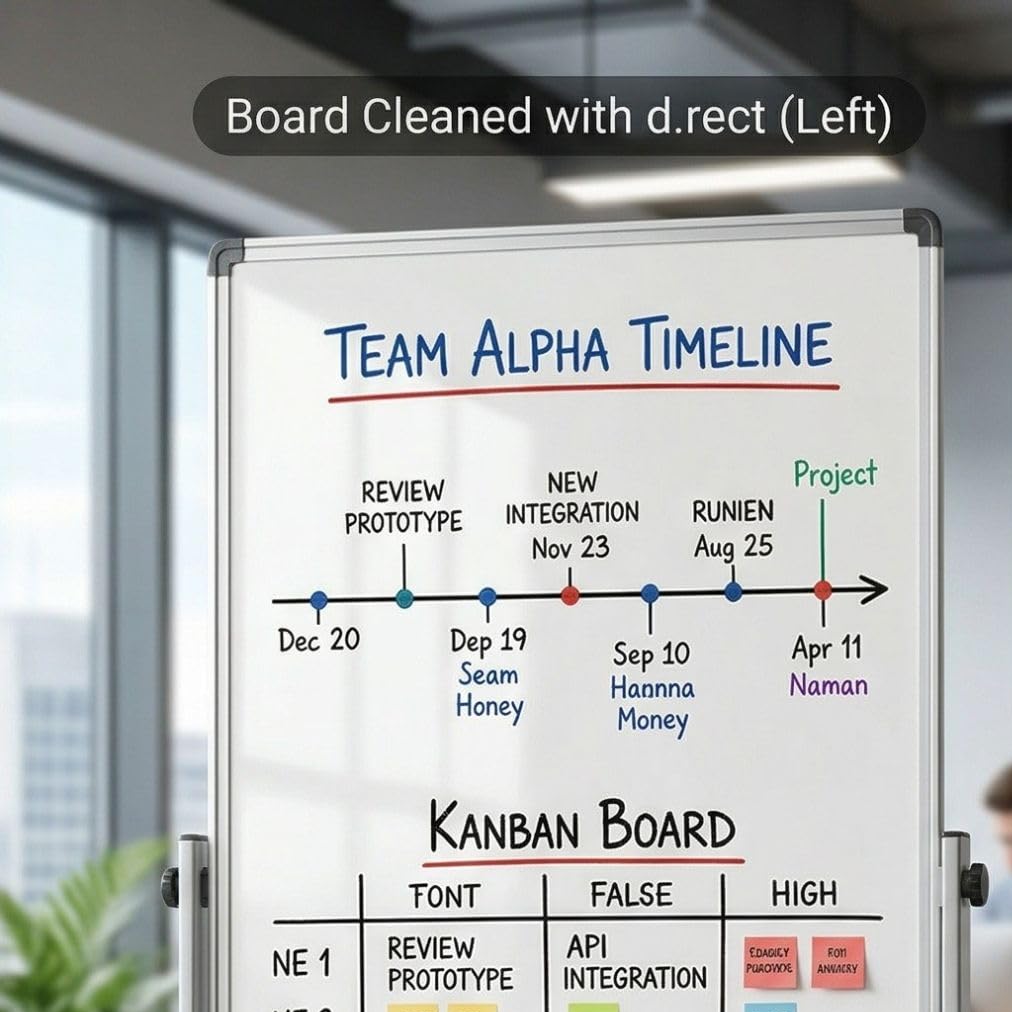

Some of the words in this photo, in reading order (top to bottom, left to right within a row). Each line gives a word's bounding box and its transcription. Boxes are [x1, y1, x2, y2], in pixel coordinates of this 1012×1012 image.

[323, 323, 448, 380] TEAM
[471, 318, 610, 377] ALPHA
[628, 314, 833, 372] TIMELINE
[548, 470, 598, 494] NEW
[794, 458, 878, 495] Project
[362, 478, 445, 503] REVIEW
[345, 509, 463, 535] PROTOTYPE
[506, 500, 639, 525] INTEGRATION
[692, 499, 774, 523] RUNIEN
[532, 536, 573, 560] Nov
[580, 534, 610, 559] 23
[694, 533, 735, 564] Aug
[744, 533, 773, 557] 25
[277, 627, 321, 653] Dec
[330, 626, 360, 651] 20
[450, 628, 492, 660] Dep
[500, 627, 527, 651] 19
[791, 634, 833, 668] Apr
[841, 633, 861, 659] 11
[613, 641, 654, 673] Sep
[662, 640, 690, 665] 10
[458, 661, 518, 686] Seam
[790, 672, 868, 697] Naman
[456, 692, 524, 727] Honey
[618, 706, 689, 740] Money
[430, 798, 579, 853] KANBAN
[598, 797, 736, 850] BOARD
[590, 881, 673, 908] FALSE
[772, 879, 837, 907] HIGH
[388, 936, 475, 960] REVIEW
[566, 933, 607, 959] API
[273, 948, 308, 977] NE
[319, 947, 330, 977] 1
[388, 967, 514, 992] PROTOTYPE
[564, 965, 707, 990] INTEGRATION
